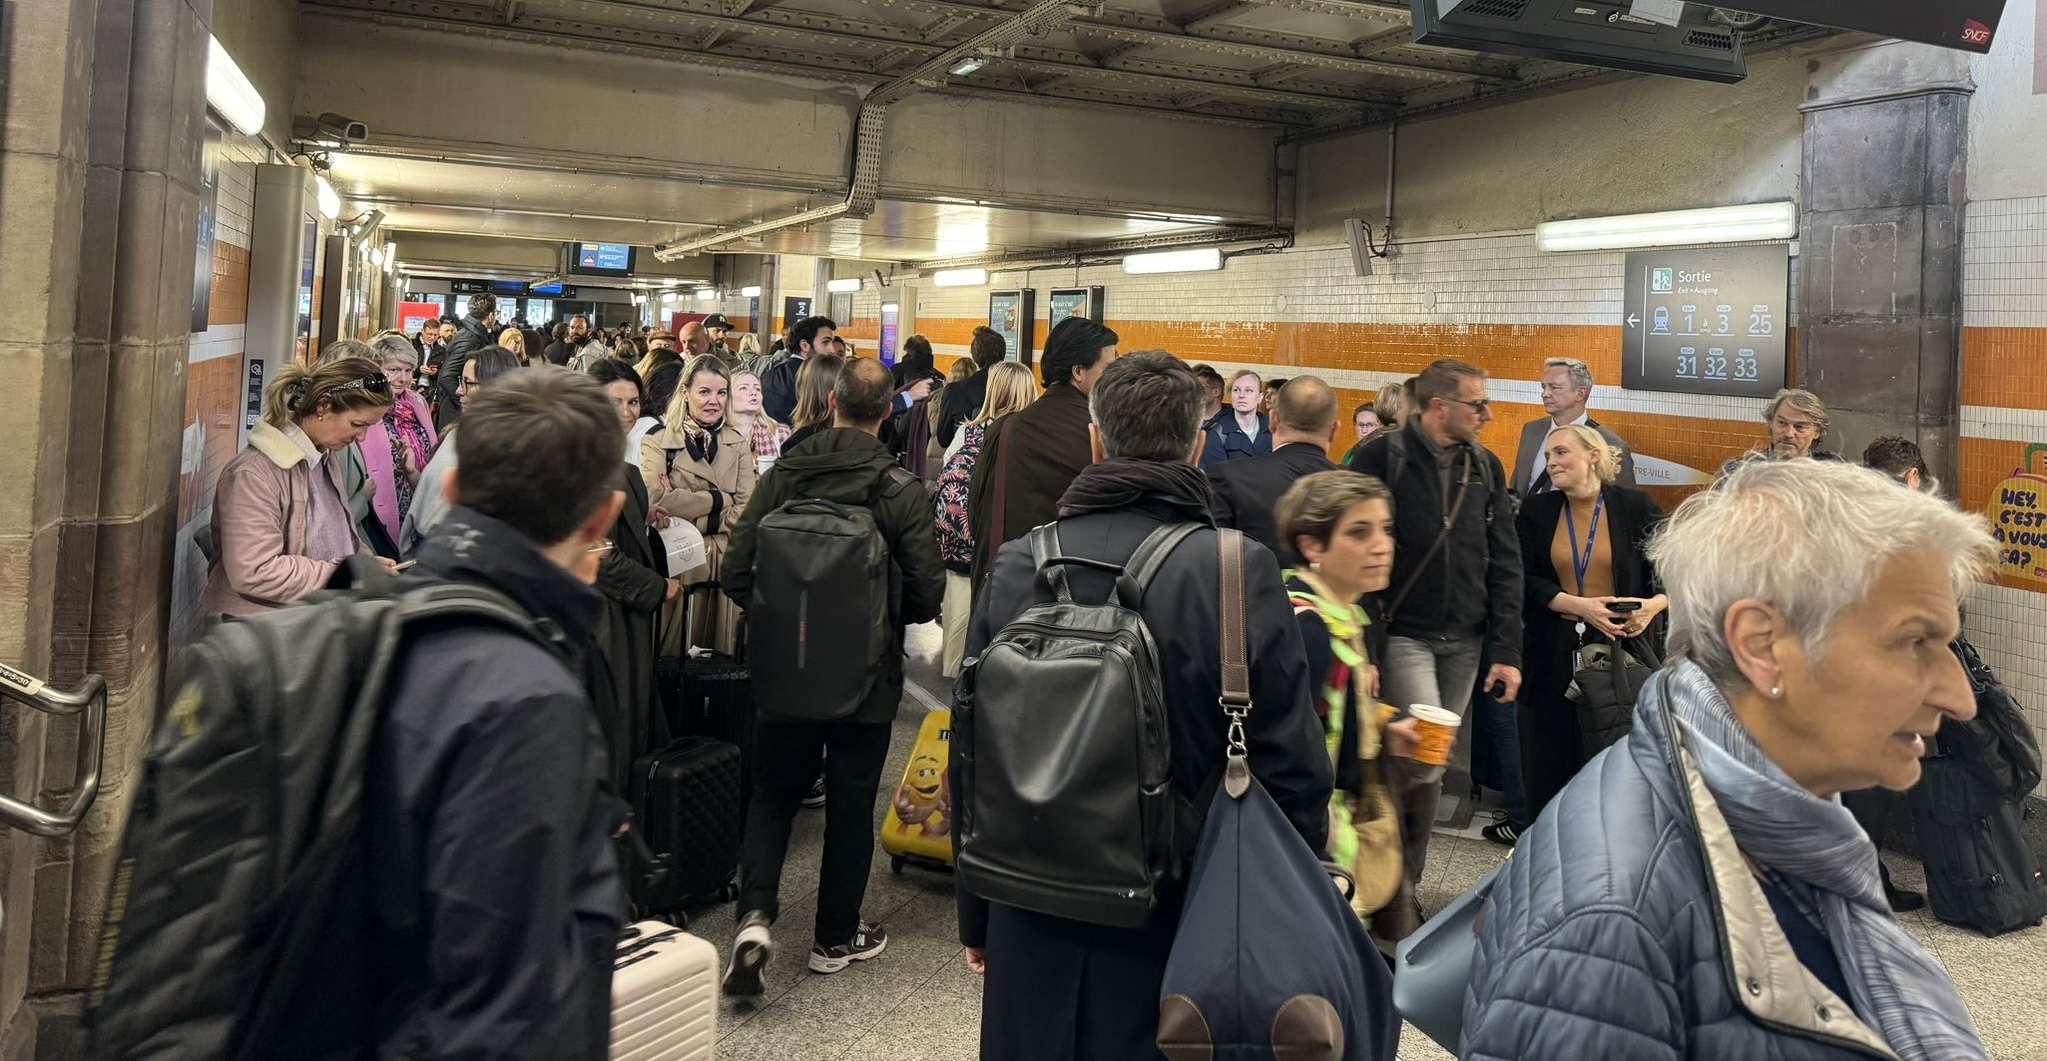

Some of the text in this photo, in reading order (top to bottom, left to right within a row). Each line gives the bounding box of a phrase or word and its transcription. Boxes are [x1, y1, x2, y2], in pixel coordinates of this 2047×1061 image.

[1962, 28, 1990, 41] SNCF
[1678, 270, 1712, 283] Sortie
[799, 305, 805, 314] 2
[1684, 313, 1693, 333] 1
[1718, 313, 1729, 333] 3
[1748, 313, 1772, 334] 25
[1676, 355, 1757, 378] 31 32 33
[1634, 466, 1671, 479] TRE-VILLE
[2001, 488, 2037, 509] HEY,
[2000, 509, 2047, 528] C'EST
[2008, 530, 2047, 549] VOUS
